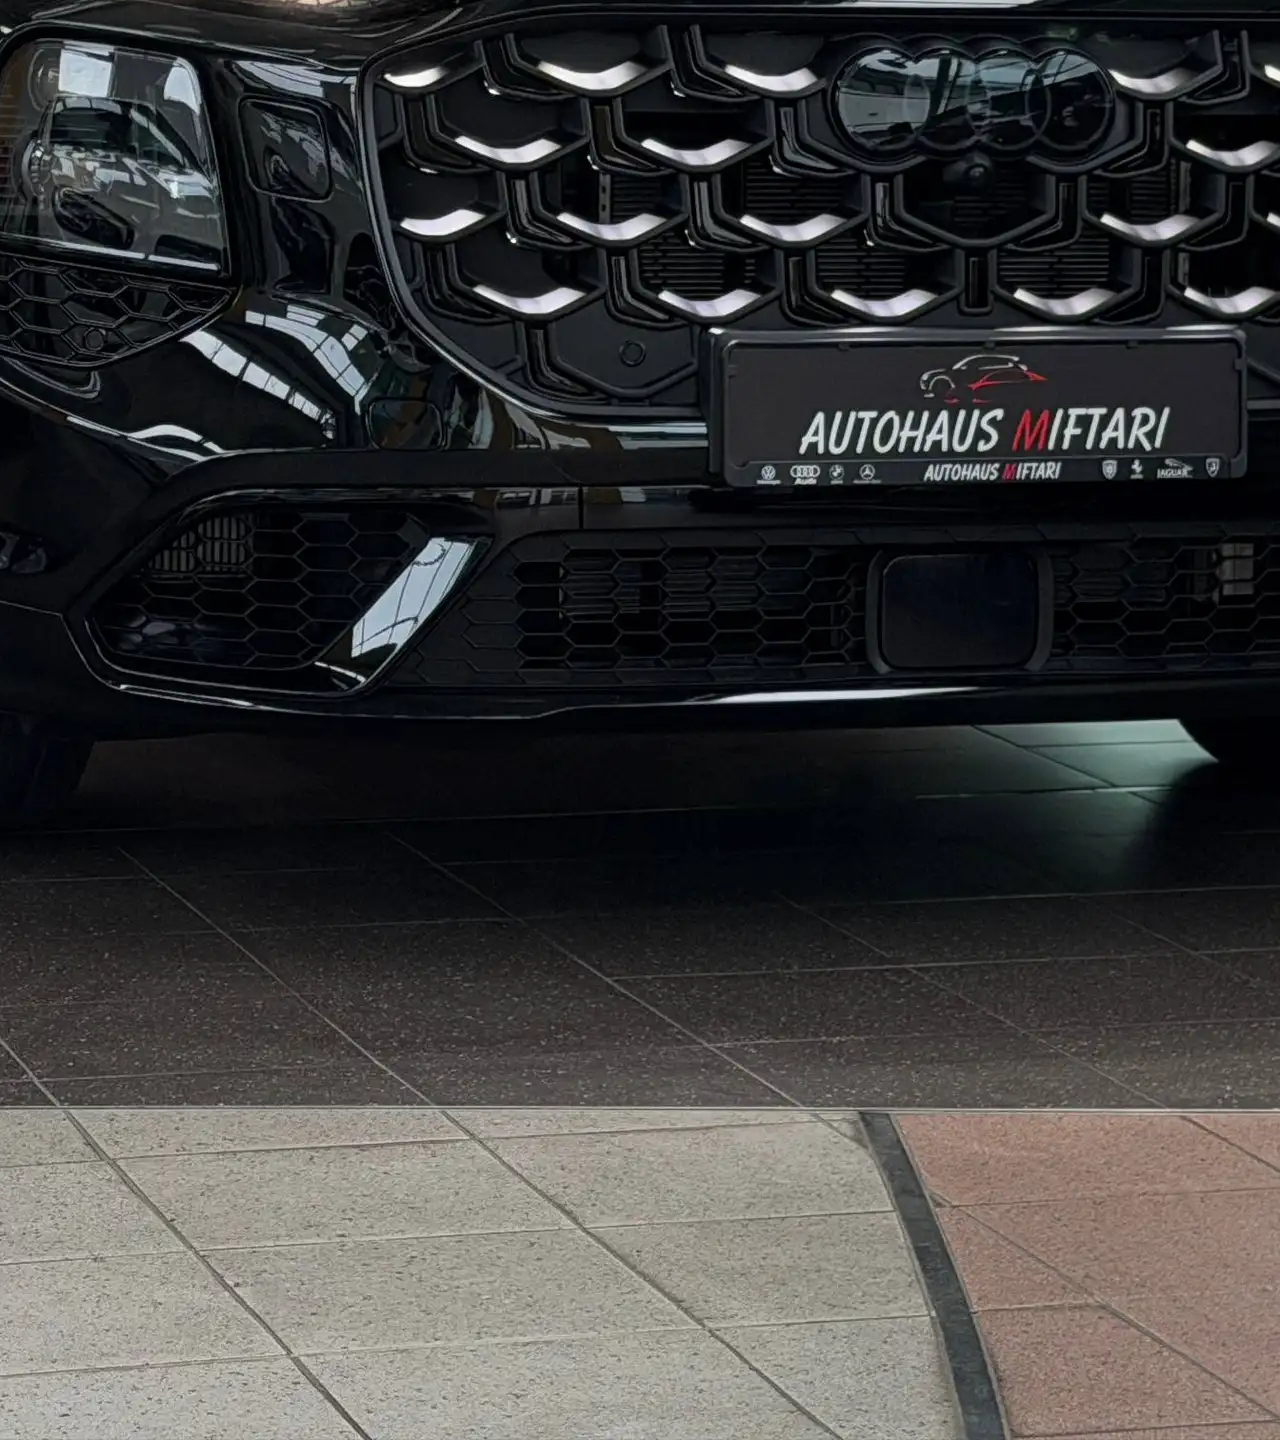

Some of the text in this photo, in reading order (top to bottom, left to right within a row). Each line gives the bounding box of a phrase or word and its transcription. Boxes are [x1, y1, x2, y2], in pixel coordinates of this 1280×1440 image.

[798, 406, 1171, 455] AUTOHAUS MIFTARI
[923, 461, 1062, 483] AUTOHAUS MIFTARI
